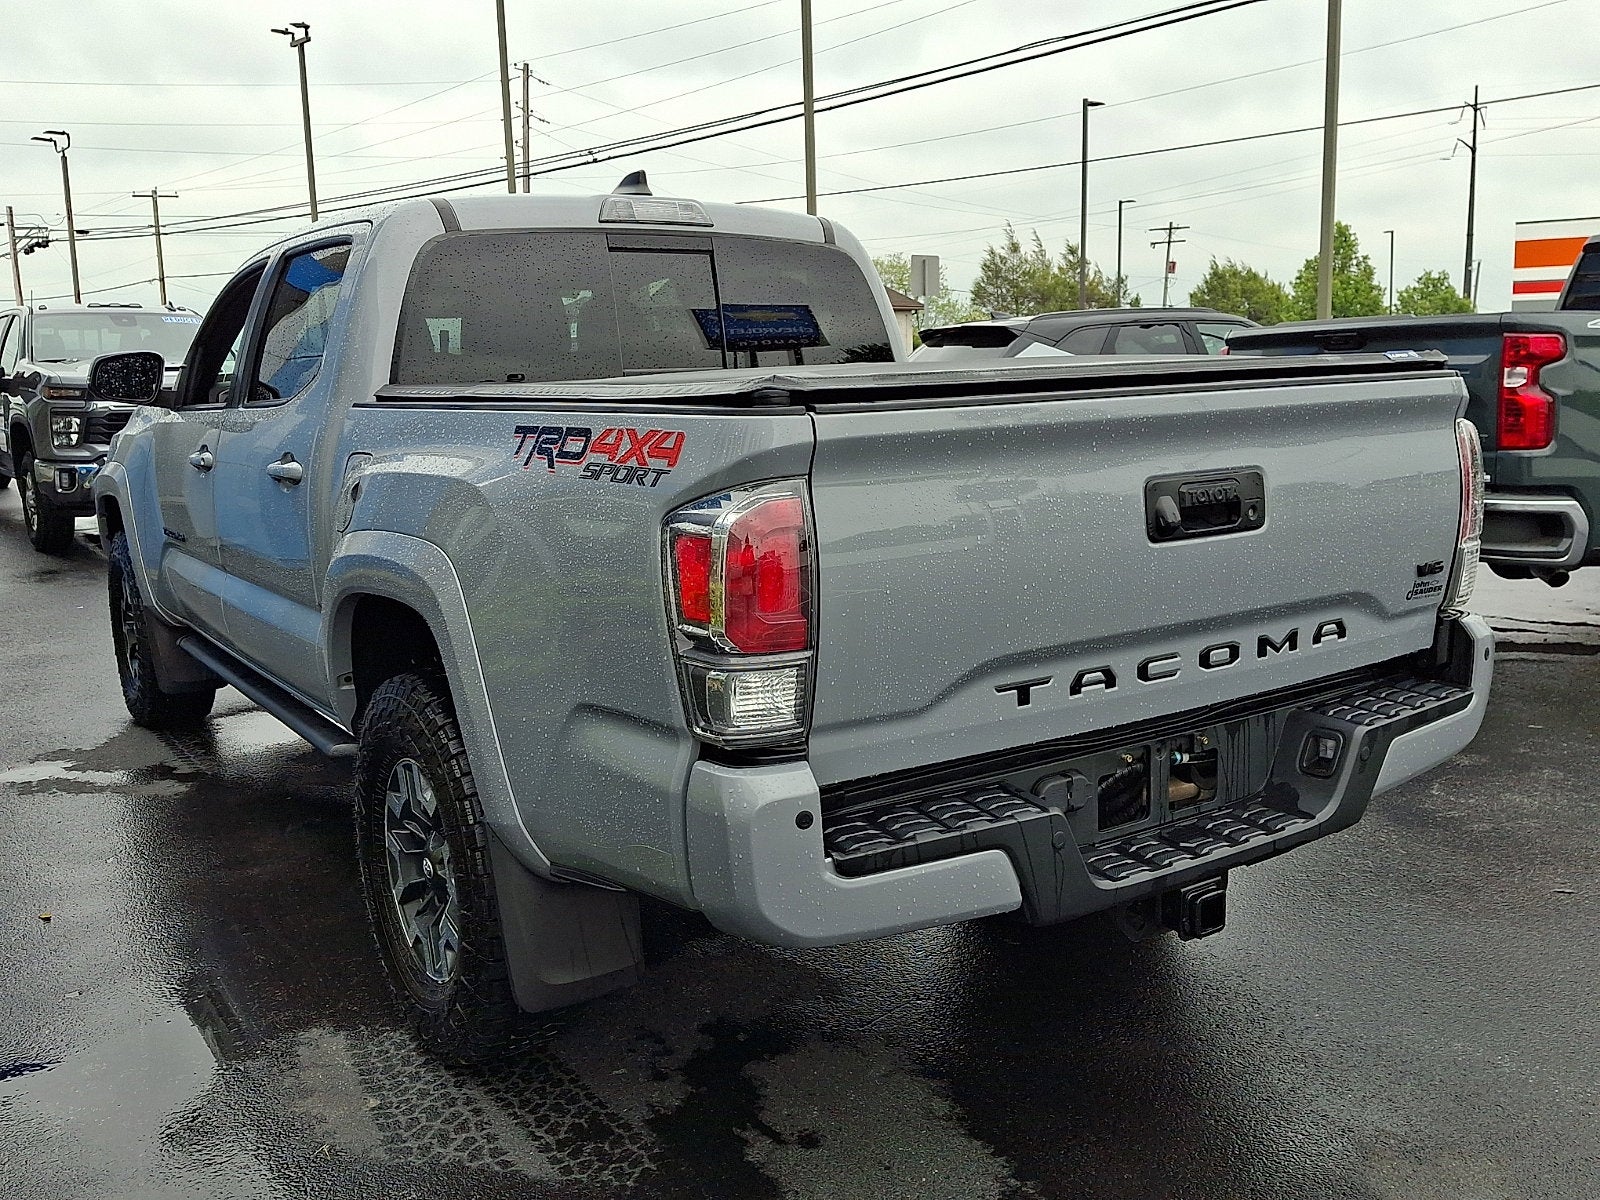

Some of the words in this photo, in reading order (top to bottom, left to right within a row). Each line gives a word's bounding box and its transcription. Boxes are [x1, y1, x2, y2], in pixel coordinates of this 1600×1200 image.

[514, 425, 592, 473] TRD
[579, 462, 672, 488] SPORT
[1186, 485, 1240, 504] TOYOTA
[994, 618, 1347, 707] TACOMA
